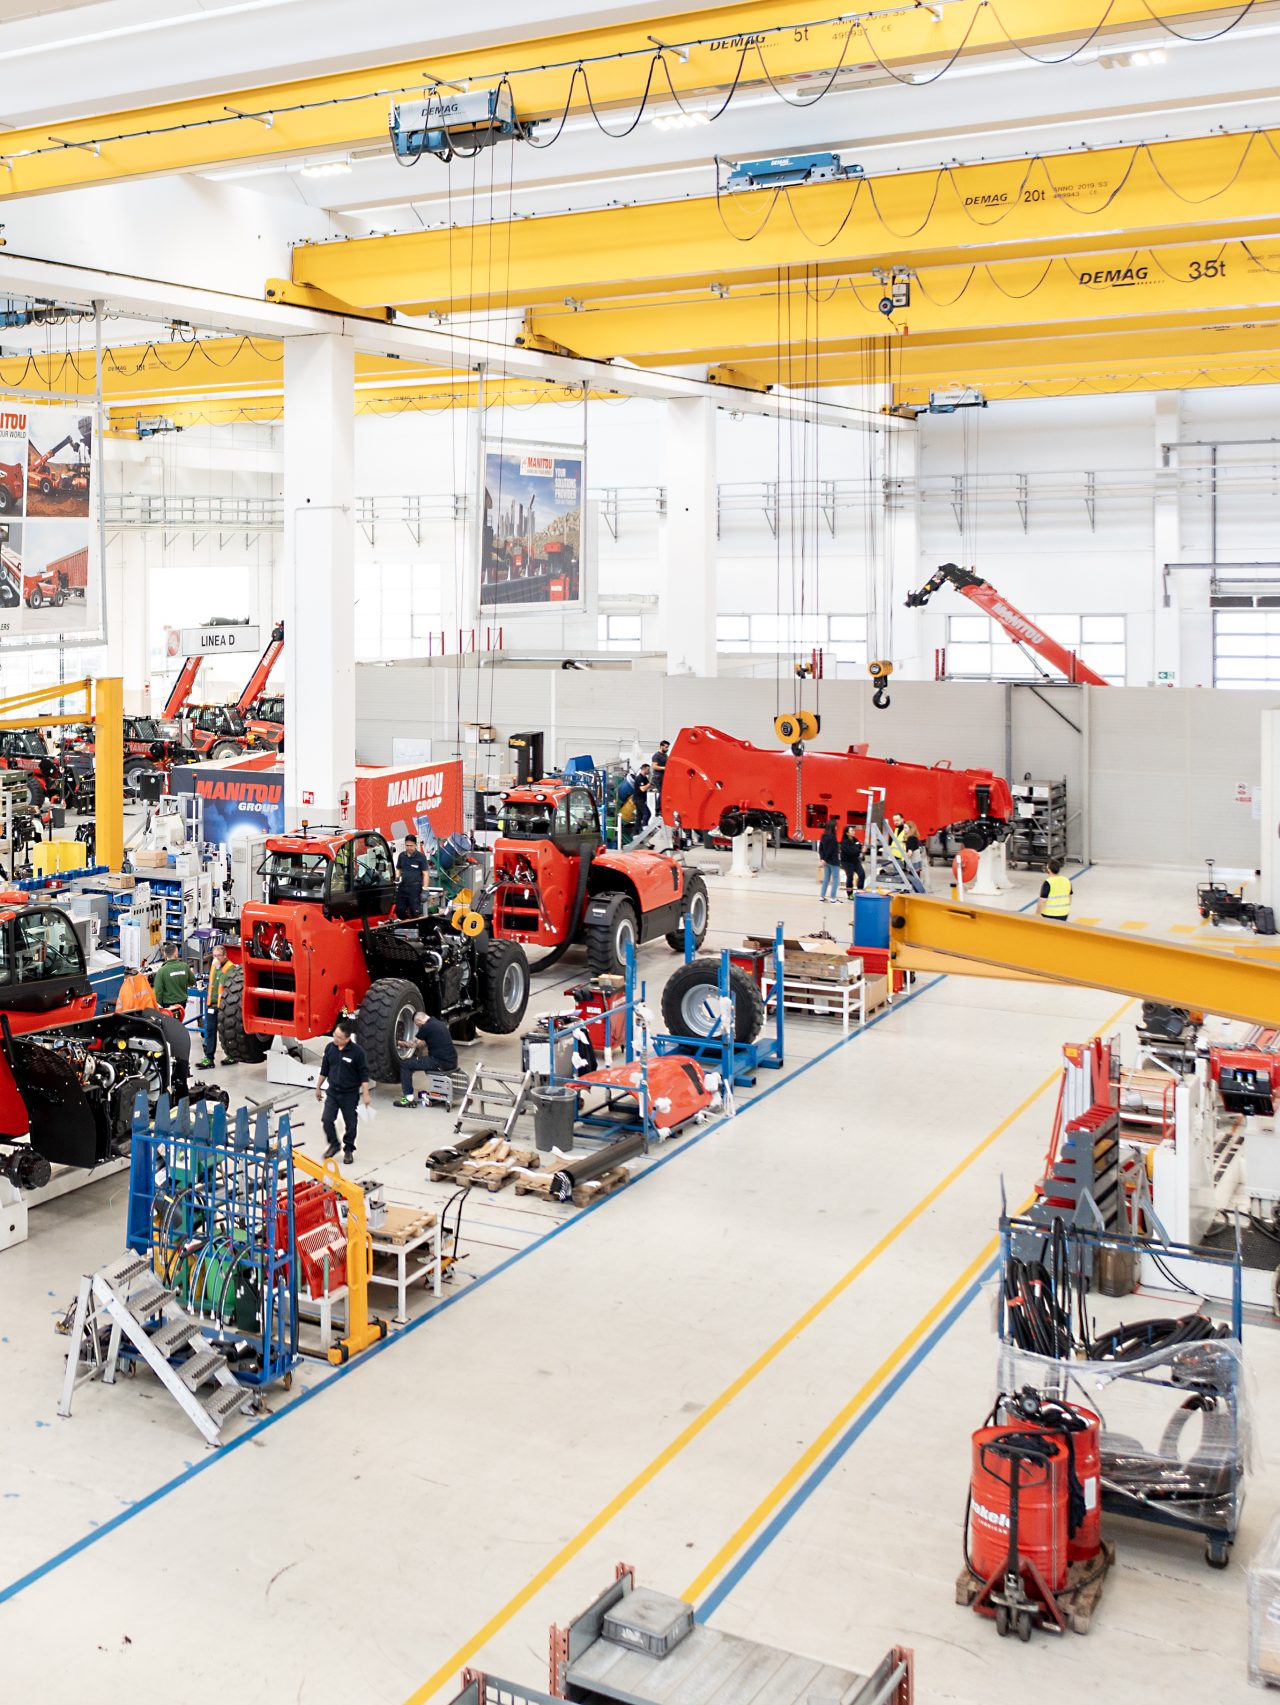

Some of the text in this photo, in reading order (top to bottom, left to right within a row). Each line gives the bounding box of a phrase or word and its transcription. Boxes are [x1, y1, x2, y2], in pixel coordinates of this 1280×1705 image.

[709, 26, 809, 51] DEMAG 5t
[421, 103, 459, 117] DEMAG
[964, 189, 1046, 206] DEMAG 20t
[1078, 259, 1227, 285] DEMAG 35t
[9, 431, 27, 439] WORLD
[527, 456, 553, 470] MANITOU
[991, 602, 1045, 644] MANITOU
[201, 634, 236, 647] LINEA D
[195, 780, 283, 802] MANITOU
[387, 772, 444, 807] MANITOU
[237, 801, 279, 813] GROUP
[415, 796, 443, 813] GROUP
